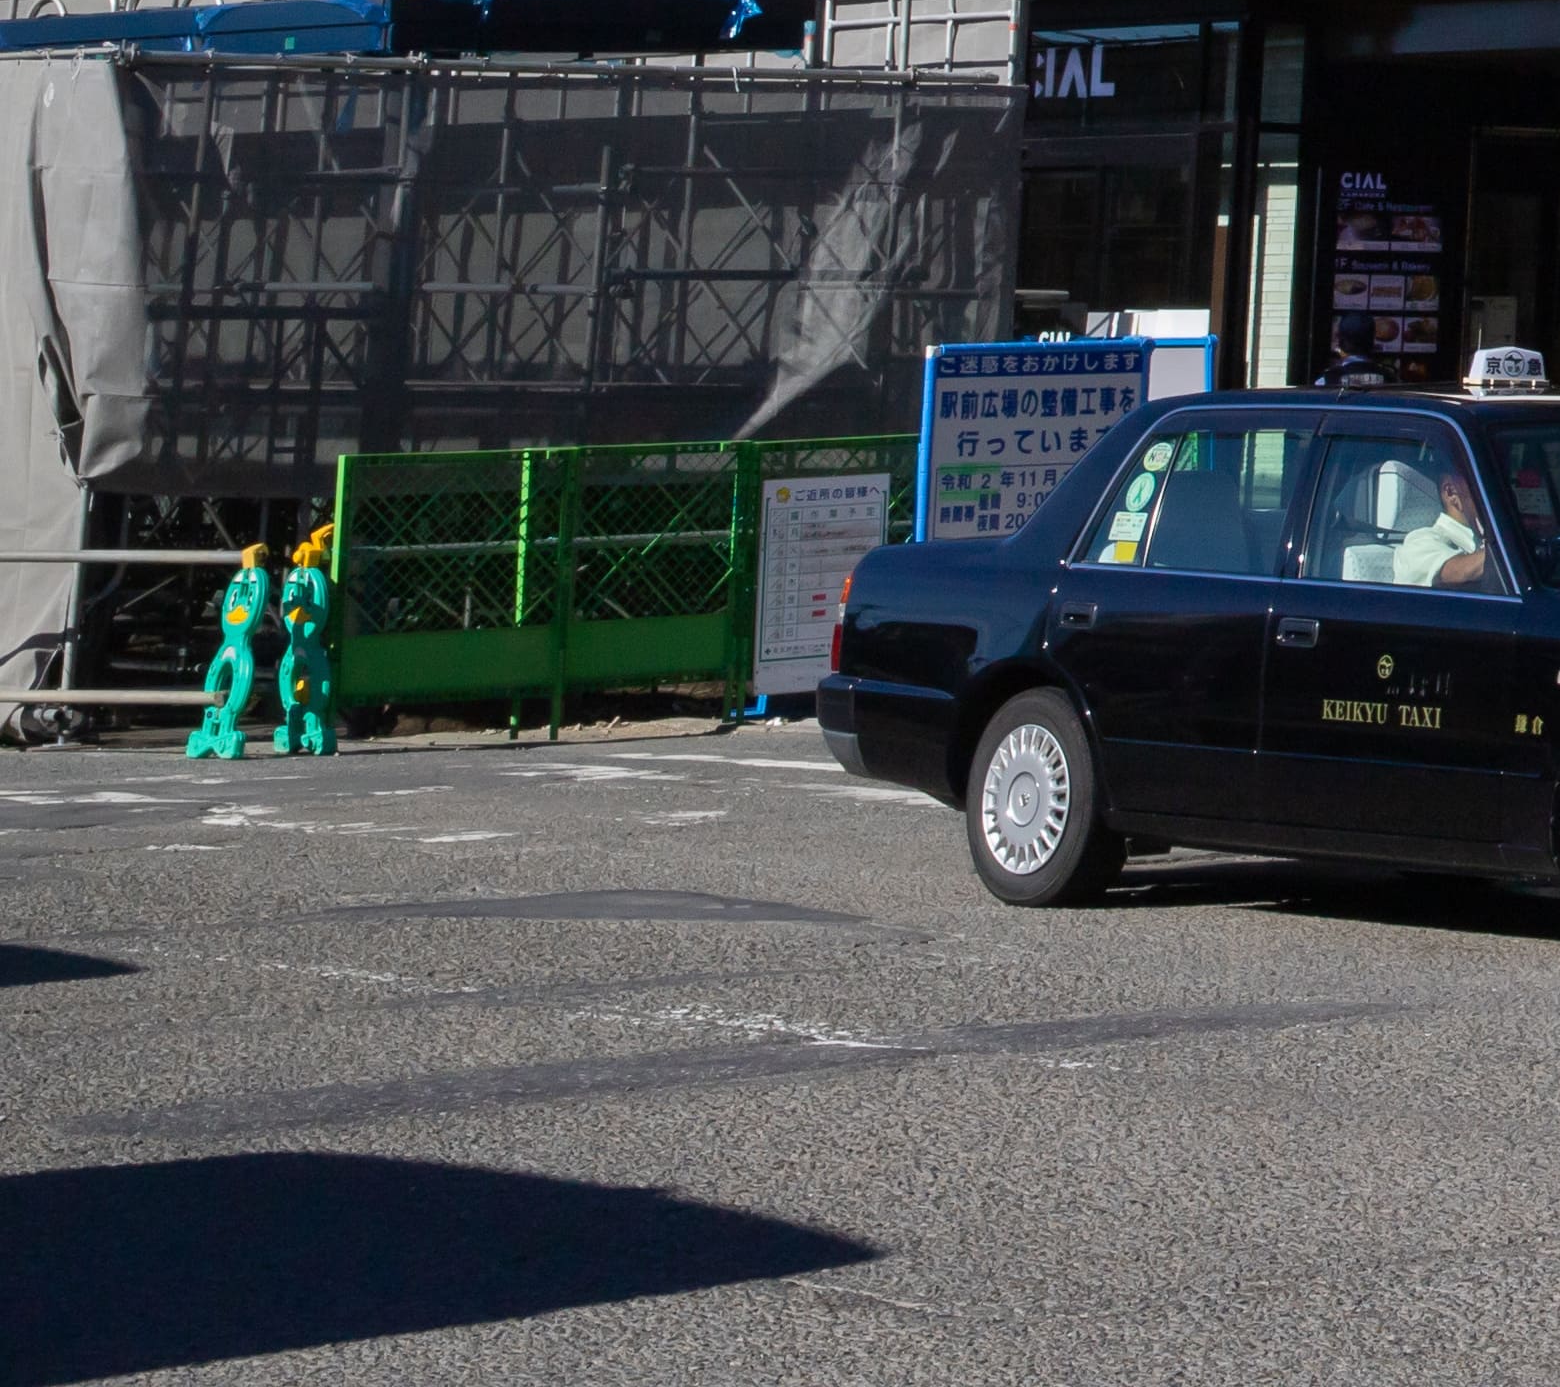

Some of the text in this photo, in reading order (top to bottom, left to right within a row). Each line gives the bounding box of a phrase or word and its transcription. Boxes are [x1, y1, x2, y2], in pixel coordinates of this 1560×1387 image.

[1034, 44, 1117, 99] IAL
[1341, 171, 1388, 190] CIAL
[939, 352, 1140, 374] ご迷惑をおかけします
[939, 385, 1136, 421] 駅前広場の整備工事を
[794, 485, 880, 502] ご近所の皆様へ
[1321, 698, 1443, 729] KEIKYU TAXI
